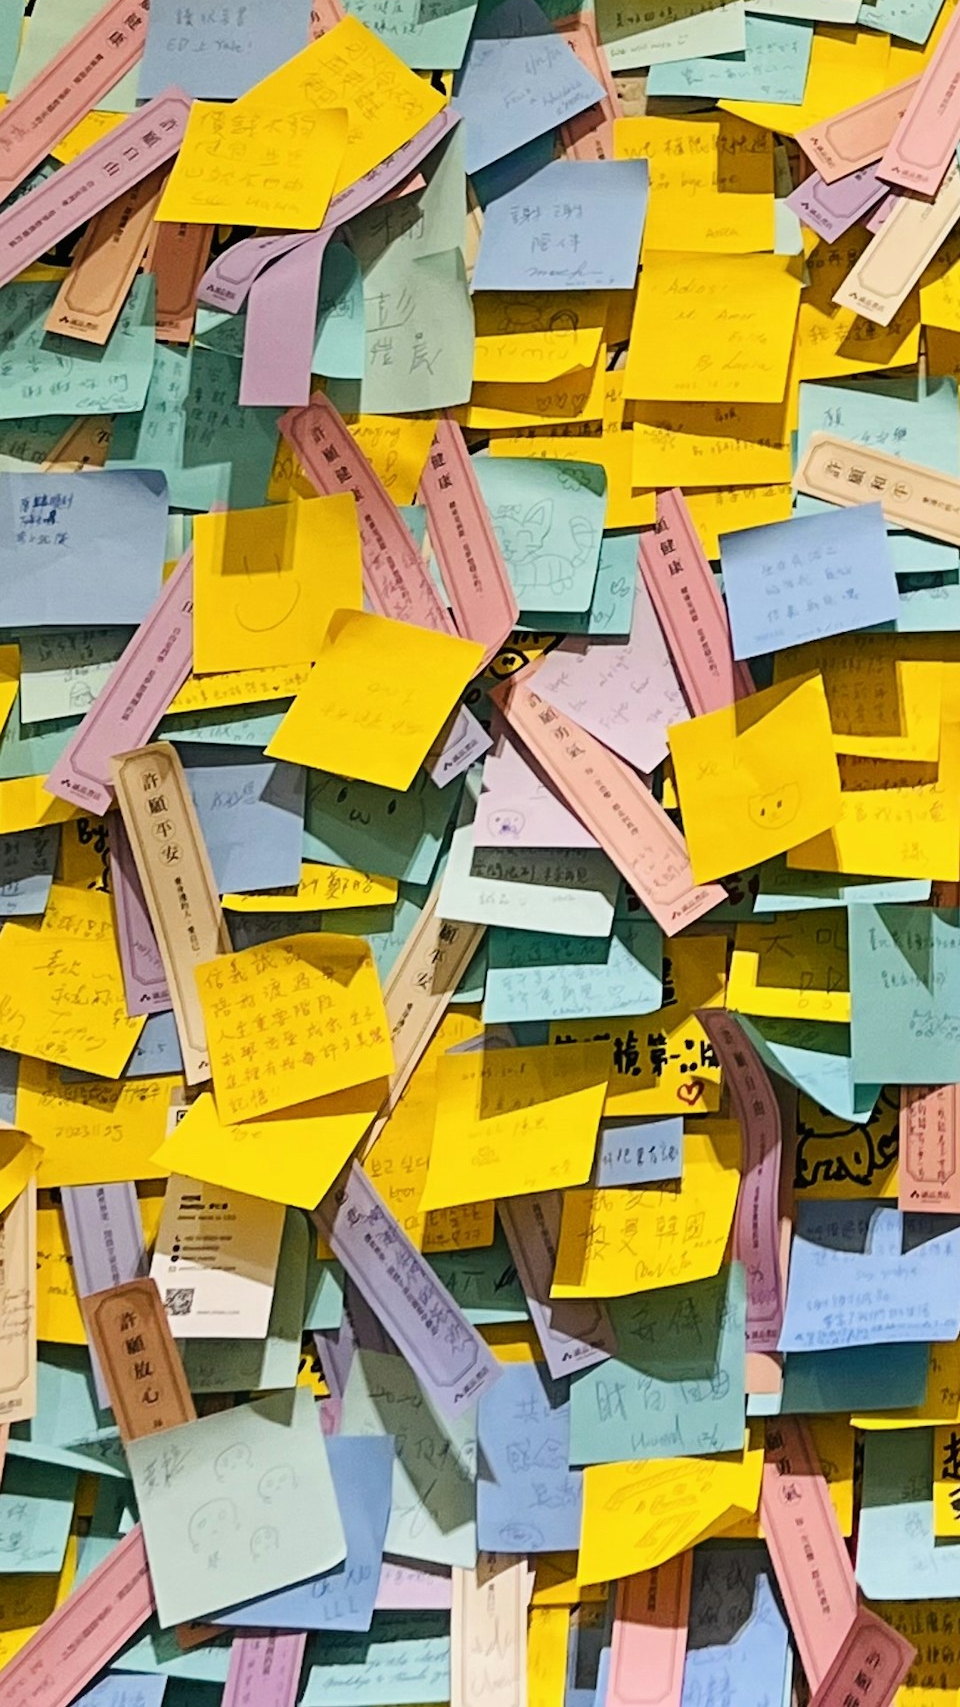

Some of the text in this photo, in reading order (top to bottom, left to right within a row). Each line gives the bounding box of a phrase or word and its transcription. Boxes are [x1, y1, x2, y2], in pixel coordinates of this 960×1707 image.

[102, 115, 180, 179] 許願自由
[142, 771, 184, 864] 許願平安
[119, 1311, 162, 1406] 許願放心
